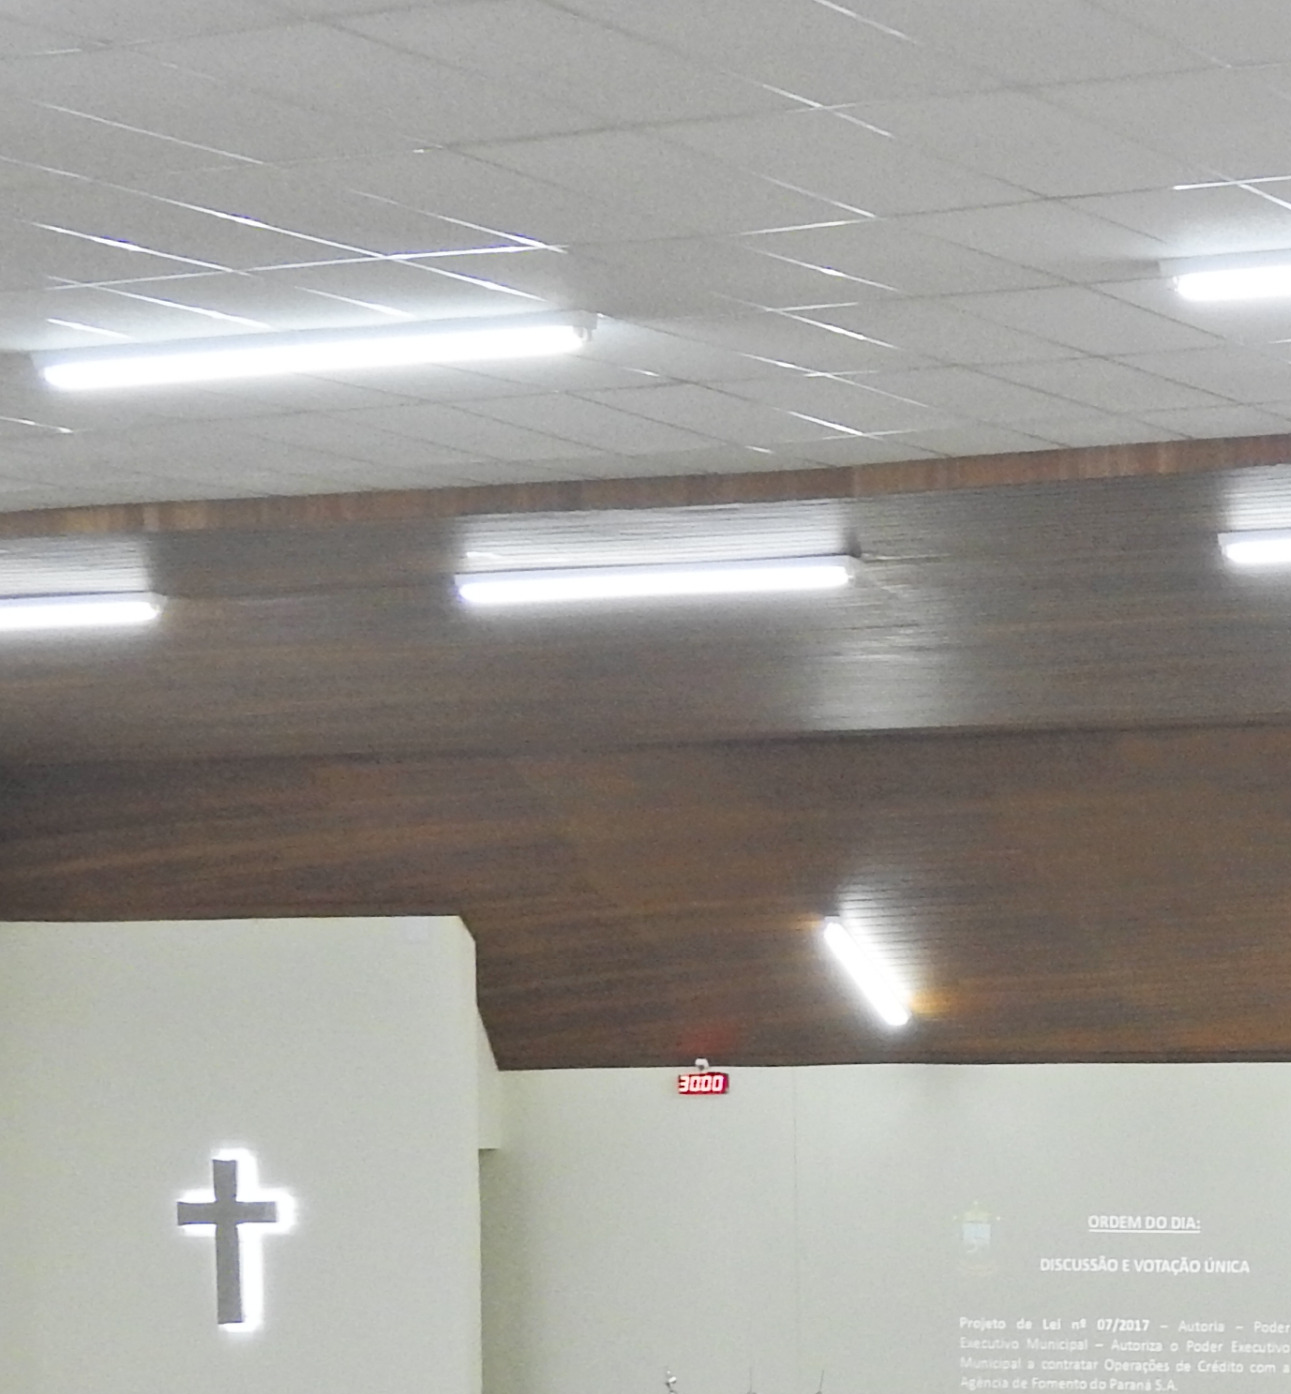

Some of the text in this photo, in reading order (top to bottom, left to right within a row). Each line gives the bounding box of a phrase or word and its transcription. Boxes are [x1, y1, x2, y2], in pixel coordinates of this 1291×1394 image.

[1088, 1215, 1201, 1230] ORDEM DO DIA:
[1040, 1256, 1250, 1276] DISCUSSÃO E VOTAÇÃO ÚNICA
[960, 1318, 1006, 1333] Projeto
[1017, 1319, 1032, 1330] de
[1043, 1319, 1061, 1330] Lei
[1097, 1319, 1150, 1332] 07/2017
[1178, 1321, 1225, 1332] Autoria
[1254, 1321, 1290, 1333] Poder
[960, 1338, 1019, 1350] Executivo
[1027, 1339, 1088, 1353] Municipal
[1111, 1340, 1162, 1352] Autoriza
[1170, 1343, 1178, 1352] o
[1186, 1341, 1223, 1352] Poder
[1231, 1341, 1290, 1354] Executivo
[960, 1357, 1290, 1374] Municipal a contratar Operações de Crédito com a
[961, 1377, 1178, 1391] Agência de Fomento do Paraná S.A.
